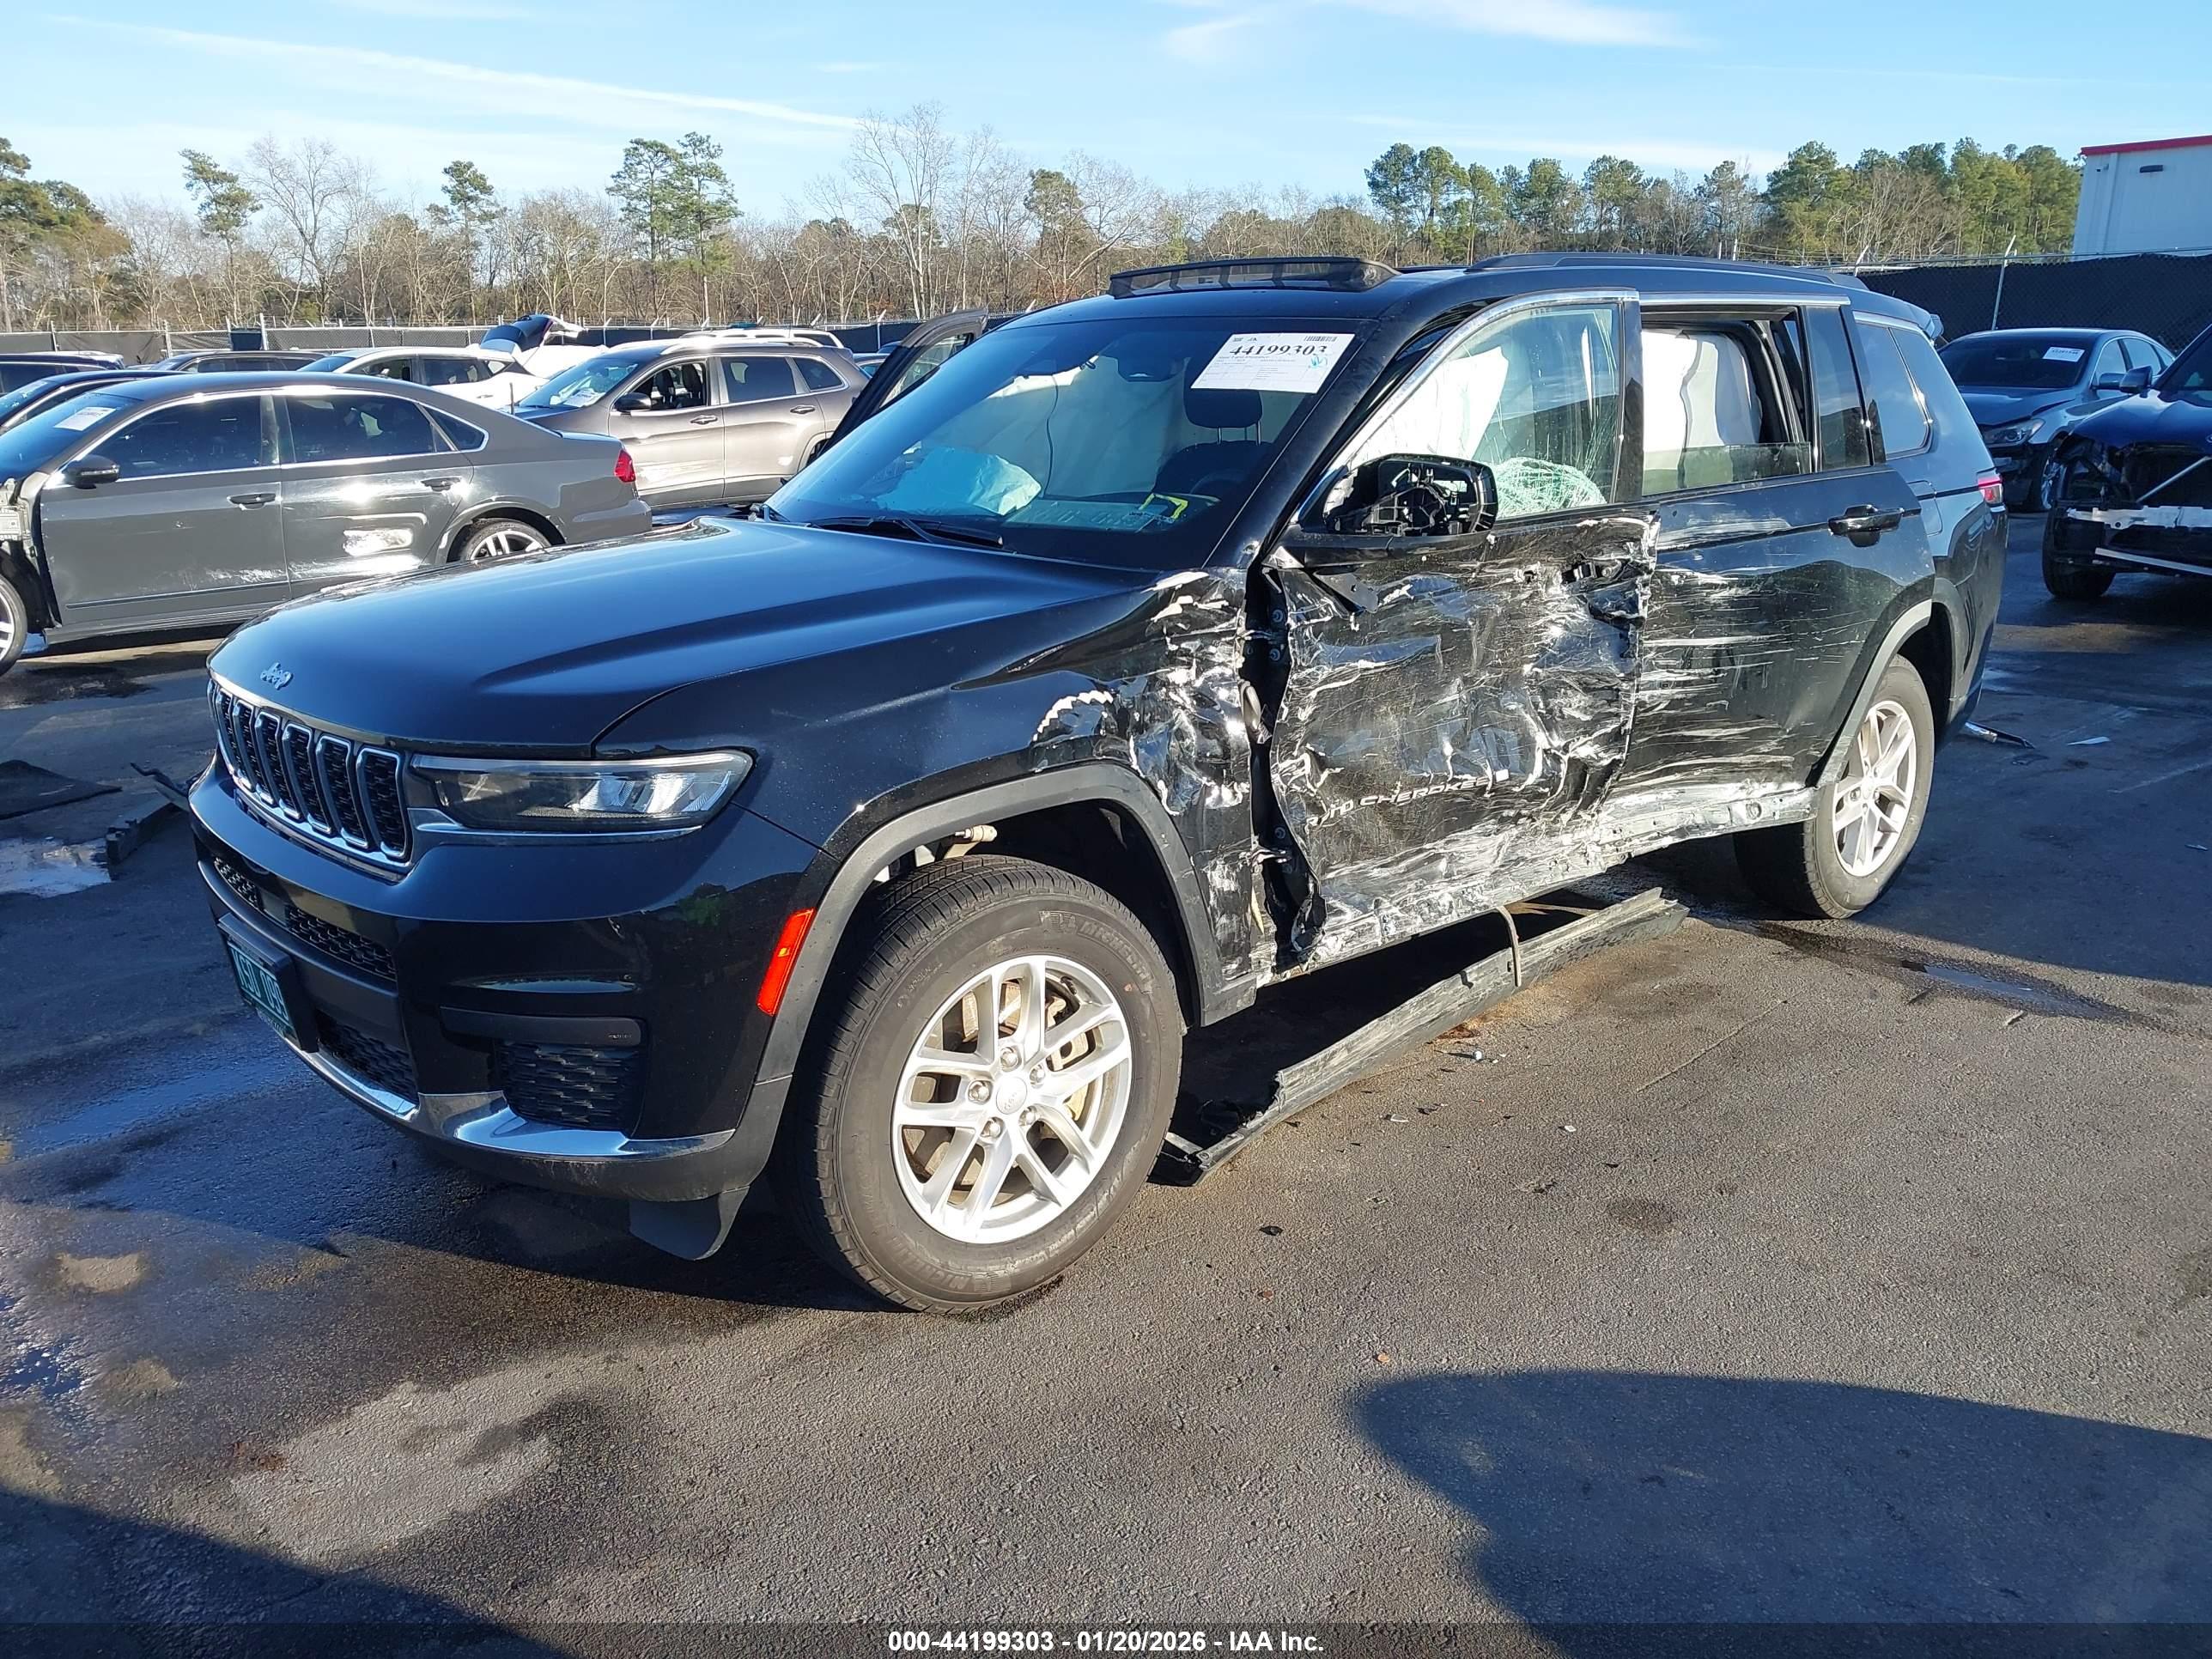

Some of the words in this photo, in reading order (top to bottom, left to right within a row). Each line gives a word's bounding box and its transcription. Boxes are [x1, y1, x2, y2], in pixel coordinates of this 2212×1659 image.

[1229, 344, 1328, 356] 44199303
[1359, 775, 1490, 805] CHEROKEE
[230, 947, 262, 998] KSD
[259, 969, 289, 1022] 099
